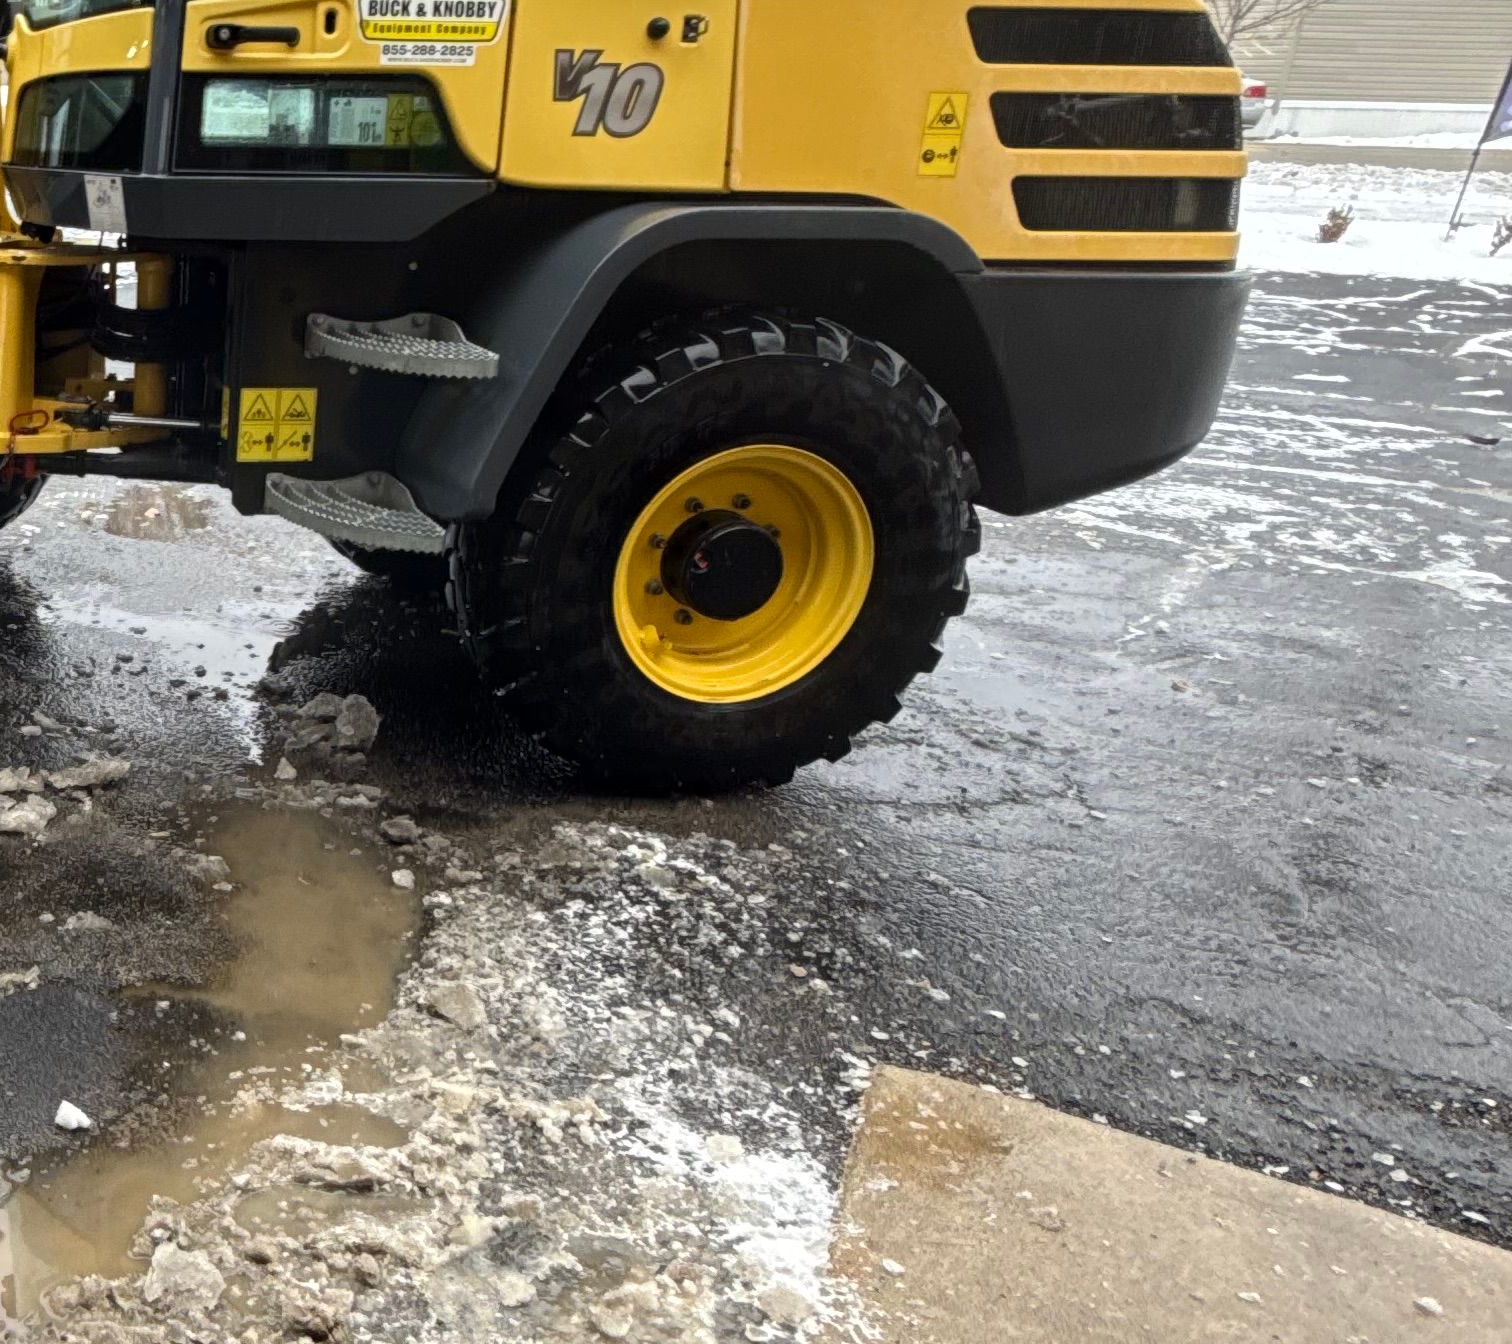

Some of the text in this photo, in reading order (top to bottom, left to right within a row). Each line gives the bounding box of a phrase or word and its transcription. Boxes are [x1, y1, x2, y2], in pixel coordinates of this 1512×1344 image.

[368, 0, 497, 18] BUCK & KNOBBY
[373, 23, 487, 35] Equipment Company
[382, 44, 474, 56] 855-288-2825
[553, 49, 665, 138] V10
